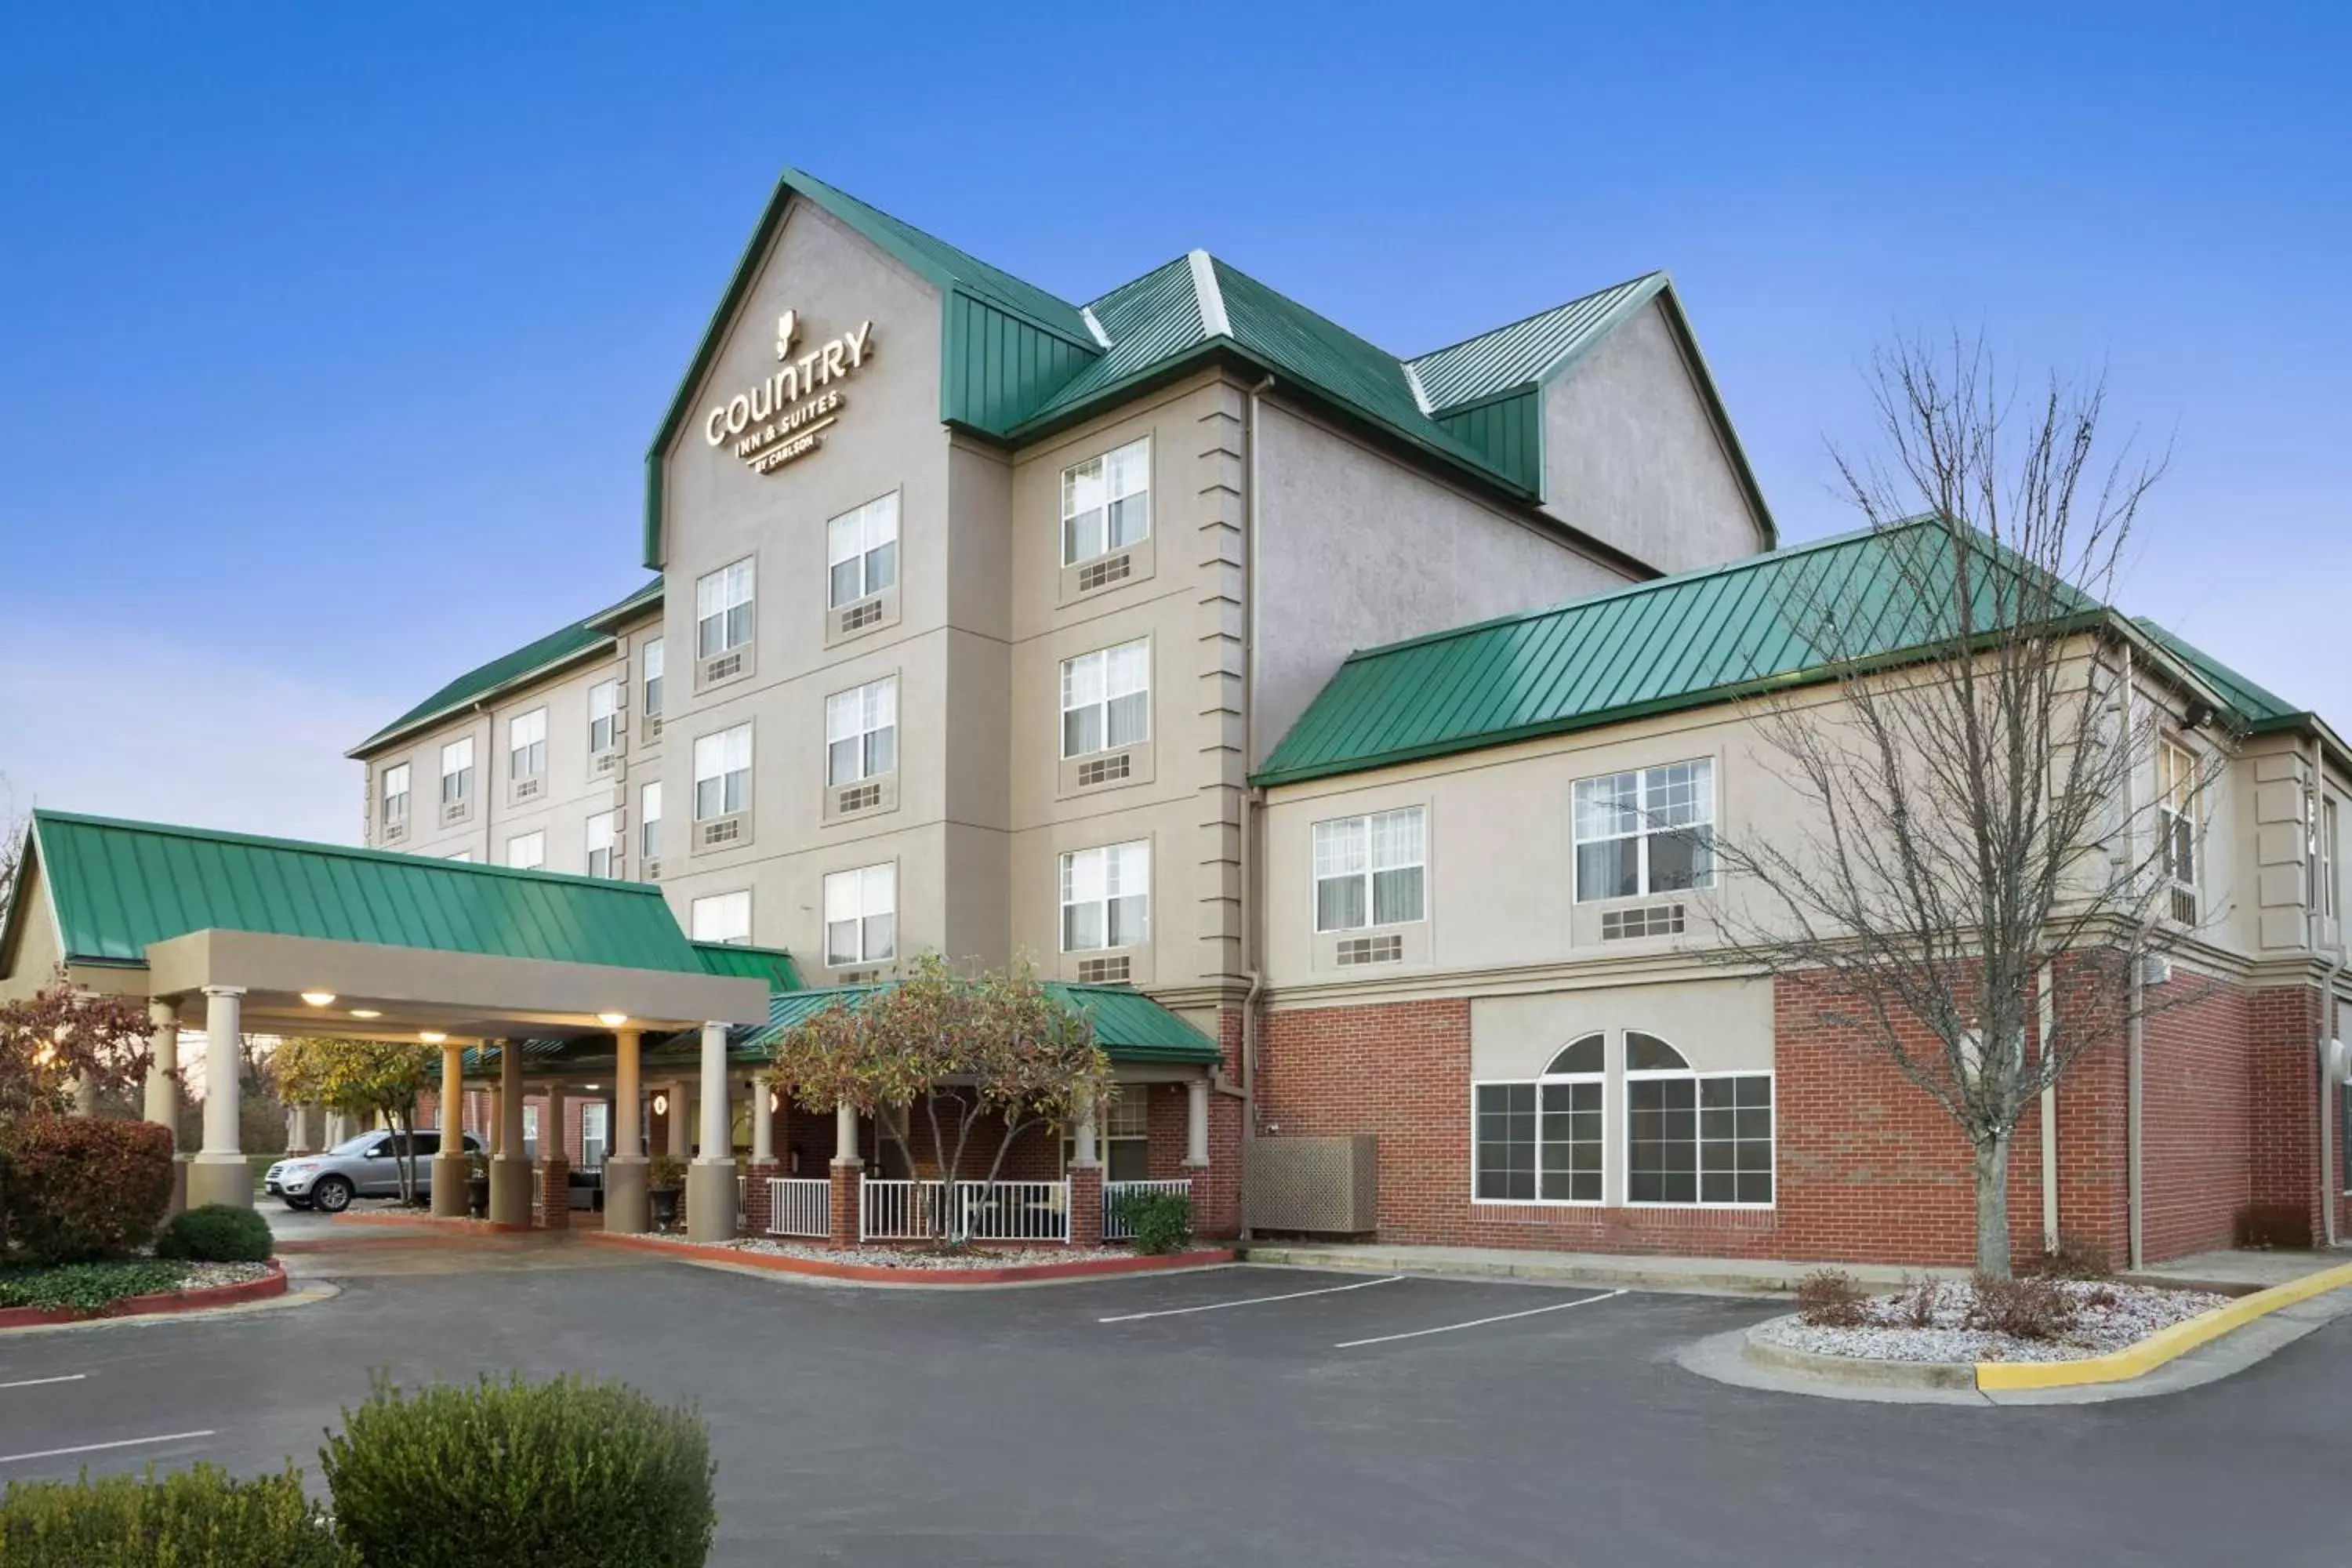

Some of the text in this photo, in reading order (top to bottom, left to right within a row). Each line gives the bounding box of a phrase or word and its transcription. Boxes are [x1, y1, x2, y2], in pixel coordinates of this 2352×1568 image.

[735, 390, 837, 459] INN & SUITES
[755, 434, 814, 474] BY CARLSON
